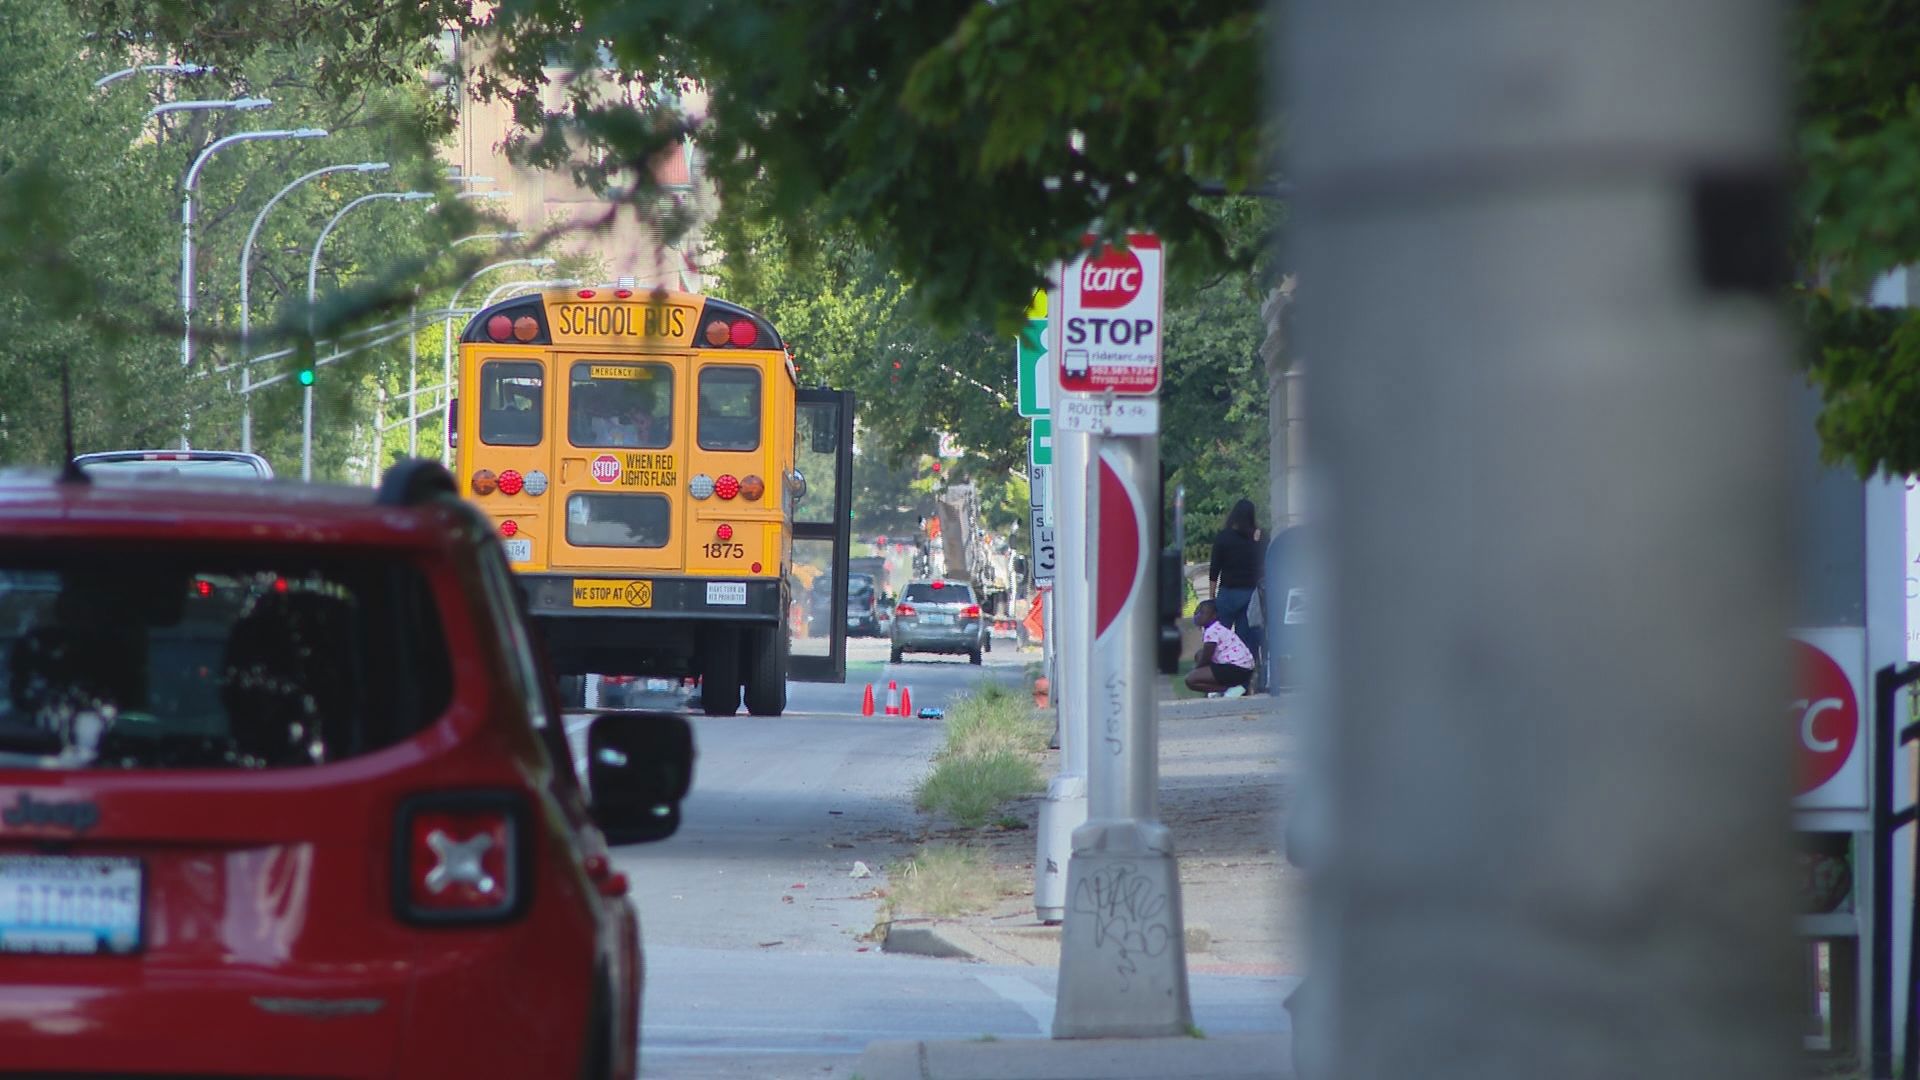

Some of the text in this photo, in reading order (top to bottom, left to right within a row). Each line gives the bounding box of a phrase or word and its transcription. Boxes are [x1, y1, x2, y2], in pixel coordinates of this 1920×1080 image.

[1083, 262, 1138, 292] tarc
[559, 305, 685, 338] SCHOOL BUS
[1066, 317, 1154, 346] STOP
[591, 366, 632, 377] EMERGENCY
[593, 460, 619, 478] STOP
[625, 453, 673, 470] WHEN RED
[621, 470, 677, 487] LIGHTS FLASH
[702, 543, 745, 559] 1875
[575, 587, 588, 600] WE
[589, 587, 612, 601] STOP
[612, 587, 623, 600] AT
